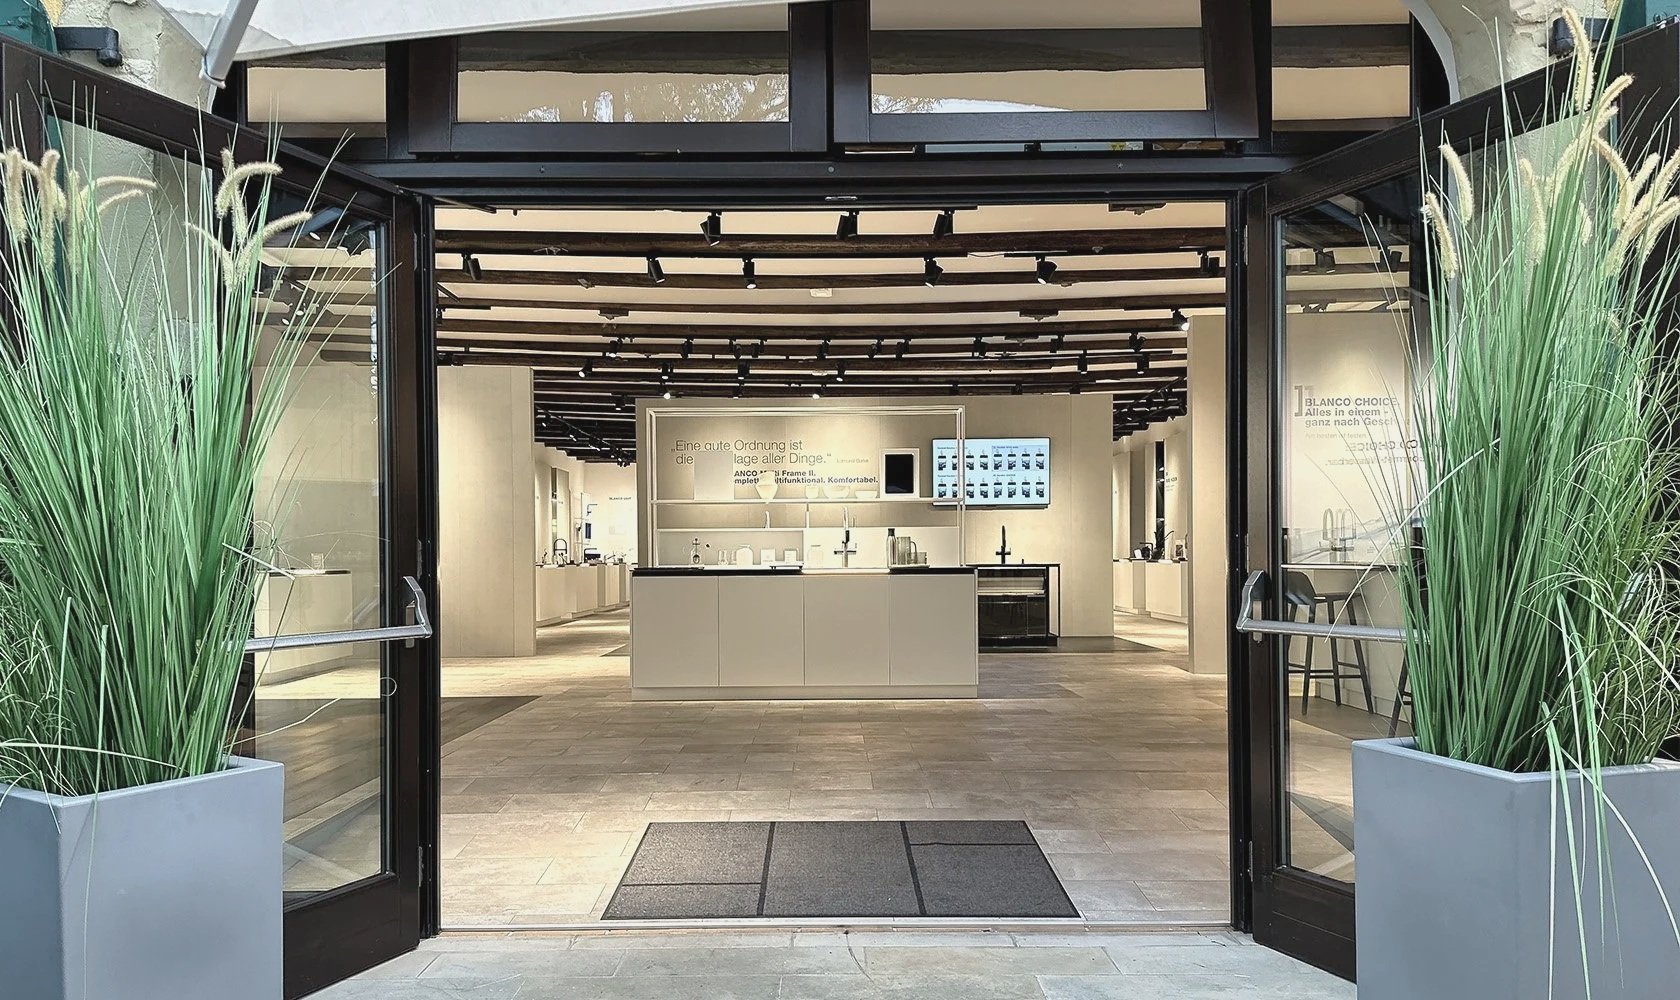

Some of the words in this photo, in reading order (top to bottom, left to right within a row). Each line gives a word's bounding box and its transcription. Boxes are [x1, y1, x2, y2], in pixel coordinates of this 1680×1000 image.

[1305, 398, 1351, 407] BLANCO
[1305, 408, 1331, 416] Alles
[1335, 408, 1344, 416] in
[1348, 408, 1380, 416] einem
[1305, 419, 1331, 428] ganz
[1334, 418, 1360, 426] nach
[704, 440, 731, 451] gute
[734, 440, 786, 453] Ordnung
[789, 440, 803, 450] ist
[676, 454, 694, 464] die
[762, 453, 785, 464] aller
